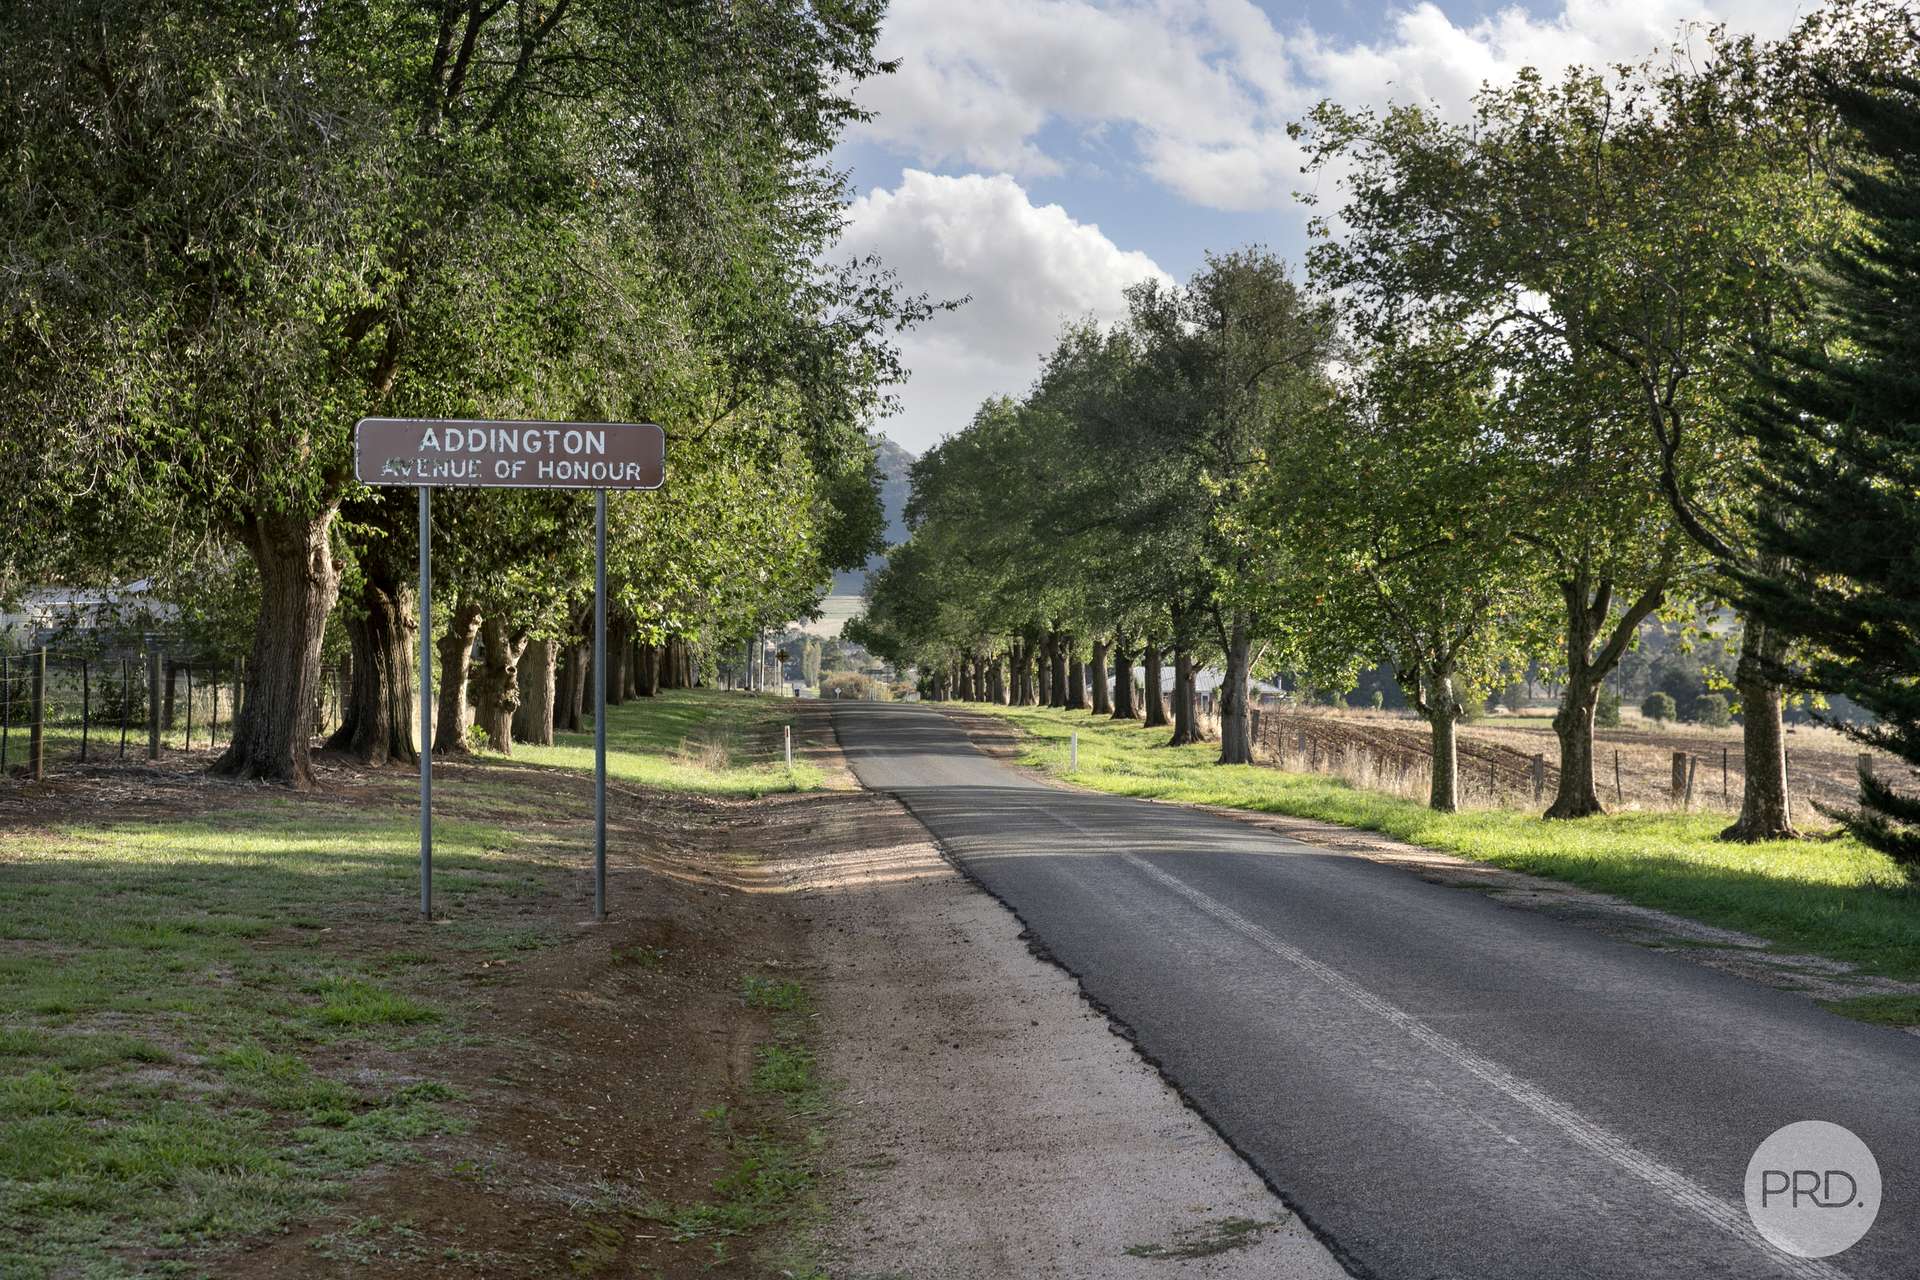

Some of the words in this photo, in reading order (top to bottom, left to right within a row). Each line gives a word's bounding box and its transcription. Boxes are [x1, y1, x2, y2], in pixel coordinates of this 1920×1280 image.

[418, 427, 606, 455] ADDINGTON
[380, 456, 482, 478] AVENUE
[494, 460, 526, 479] OF
[538, 460, 641, 481] HONOUR
